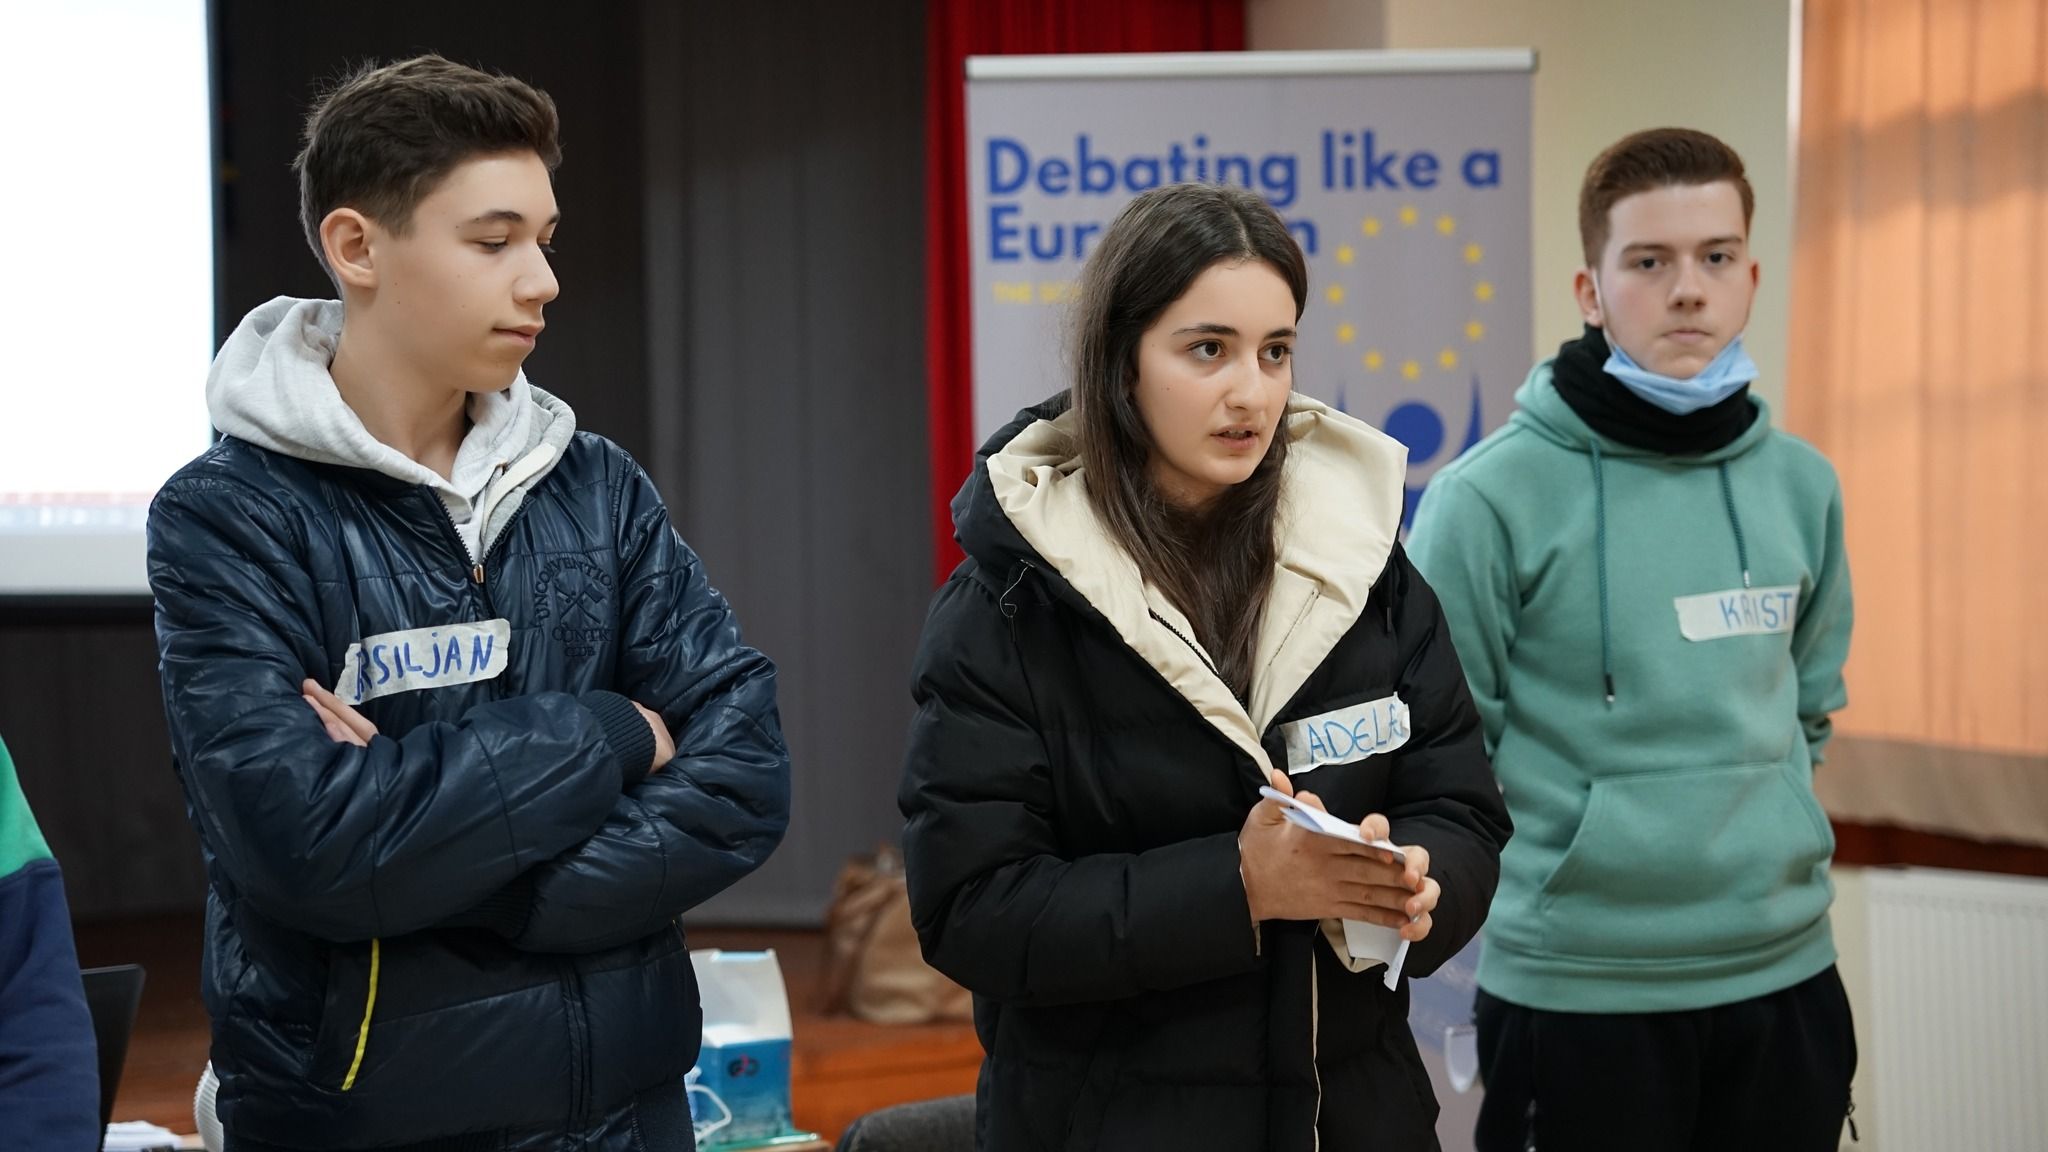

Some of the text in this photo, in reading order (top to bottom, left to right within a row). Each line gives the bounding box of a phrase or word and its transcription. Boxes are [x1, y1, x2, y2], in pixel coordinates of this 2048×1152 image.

[986, 129, 1501, 206] Debating like a
[988, 205, 1319, 261] Eurn
